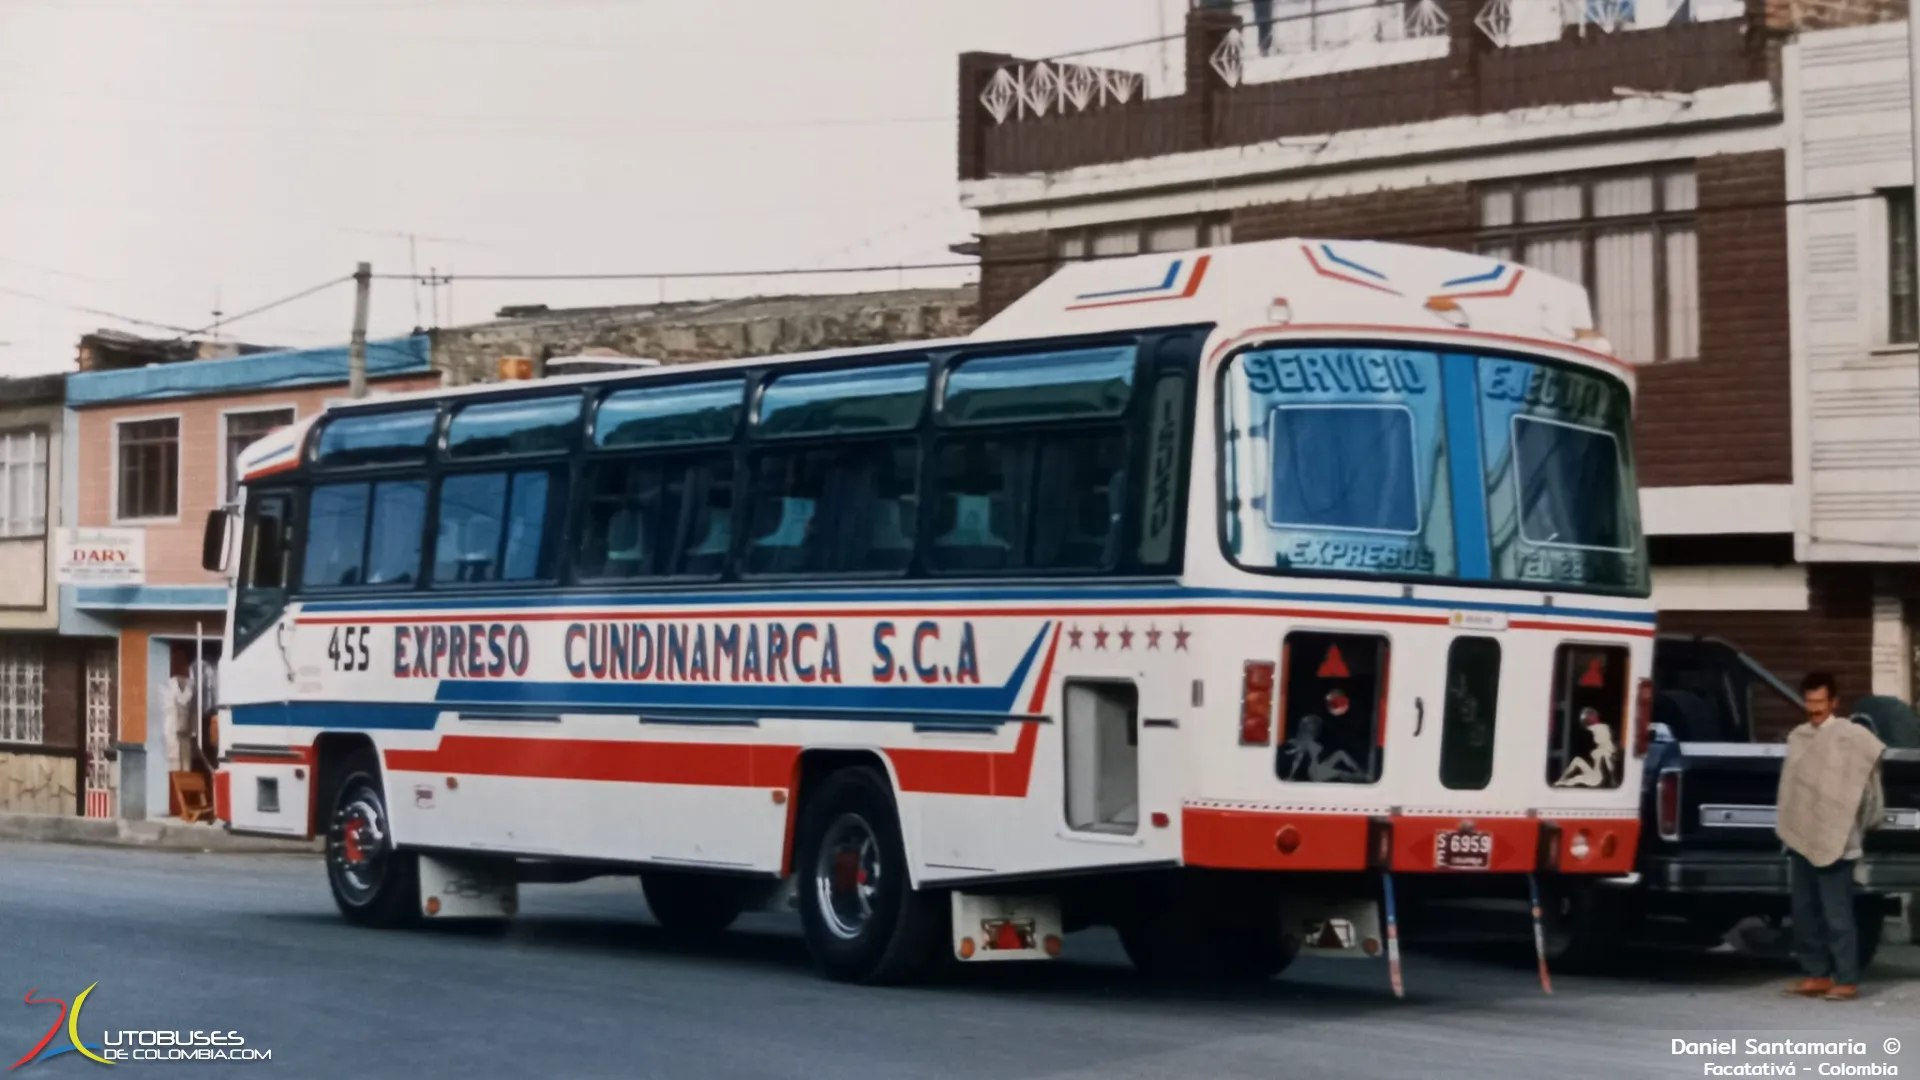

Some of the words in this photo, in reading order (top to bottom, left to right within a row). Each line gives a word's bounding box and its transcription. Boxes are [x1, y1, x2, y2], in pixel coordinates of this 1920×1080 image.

[1243, 350, 1427, 396] SERVICIO
[73, 549, 128, 562] DARY
[327, 625, 371, 672] 455
[393, 623, 530, 679] EXPRESO
[564, 622, 842, 684] CUNDINAMARCA
[871, 620, 982, 684] S.C.A
[1450, 834, 1491, 853] 6959
